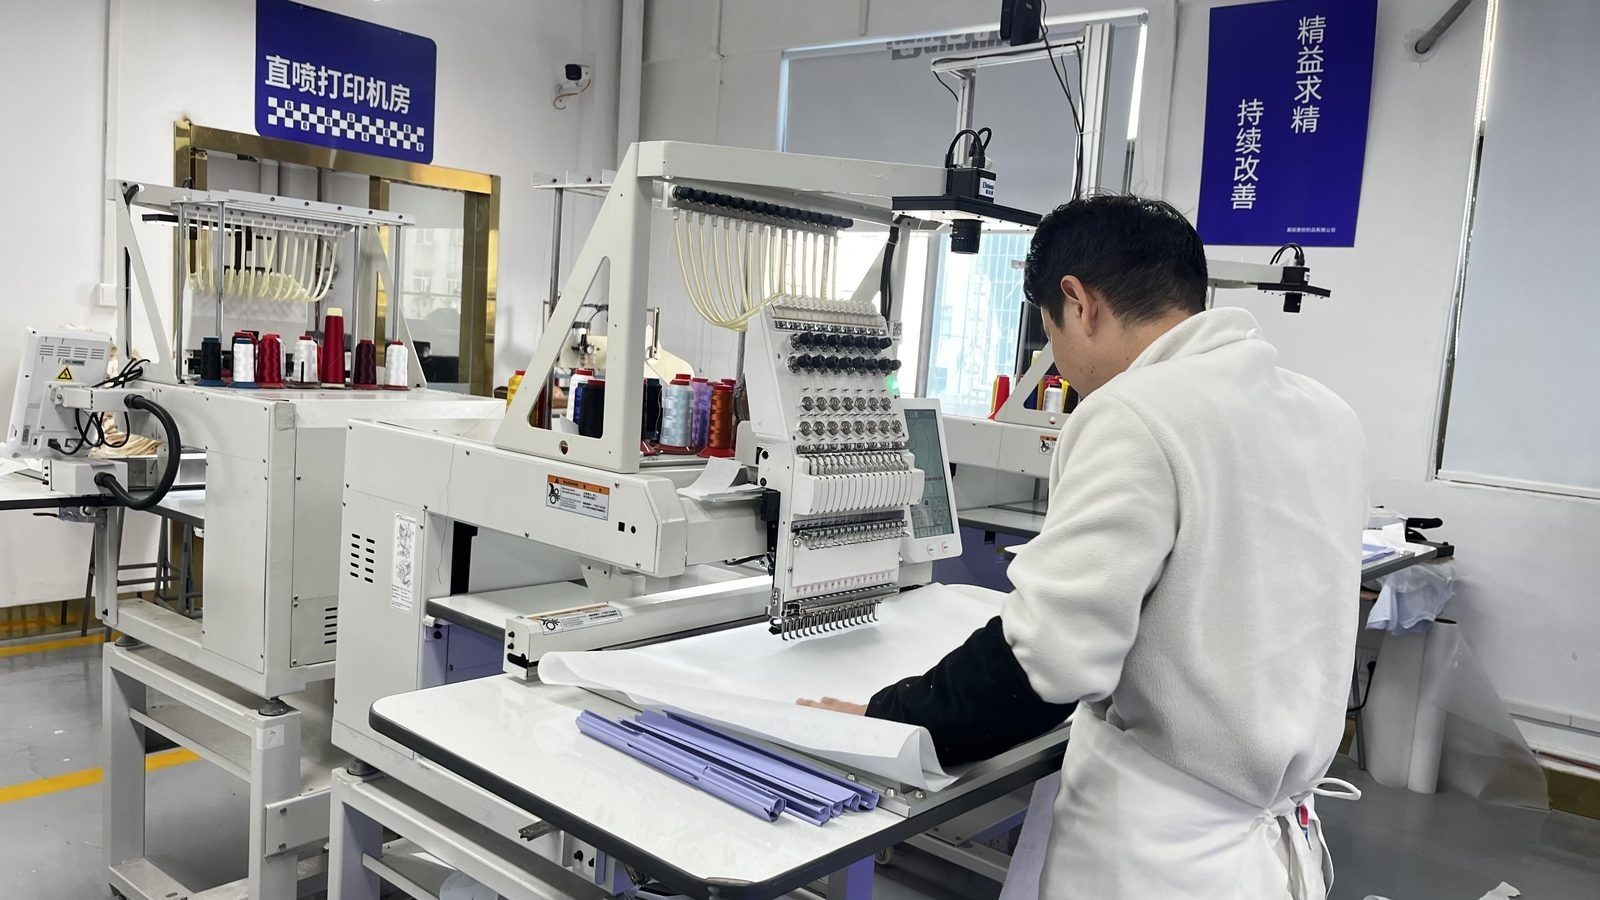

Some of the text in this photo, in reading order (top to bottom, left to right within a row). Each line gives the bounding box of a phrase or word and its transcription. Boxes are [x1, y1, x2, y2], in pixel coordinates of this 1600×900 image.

[265, 55, 411, 114] 直喷打印机房
[1291, 15, 1326, 134] 精益求精
[1230, 98, 1264, 210] 持续改善
